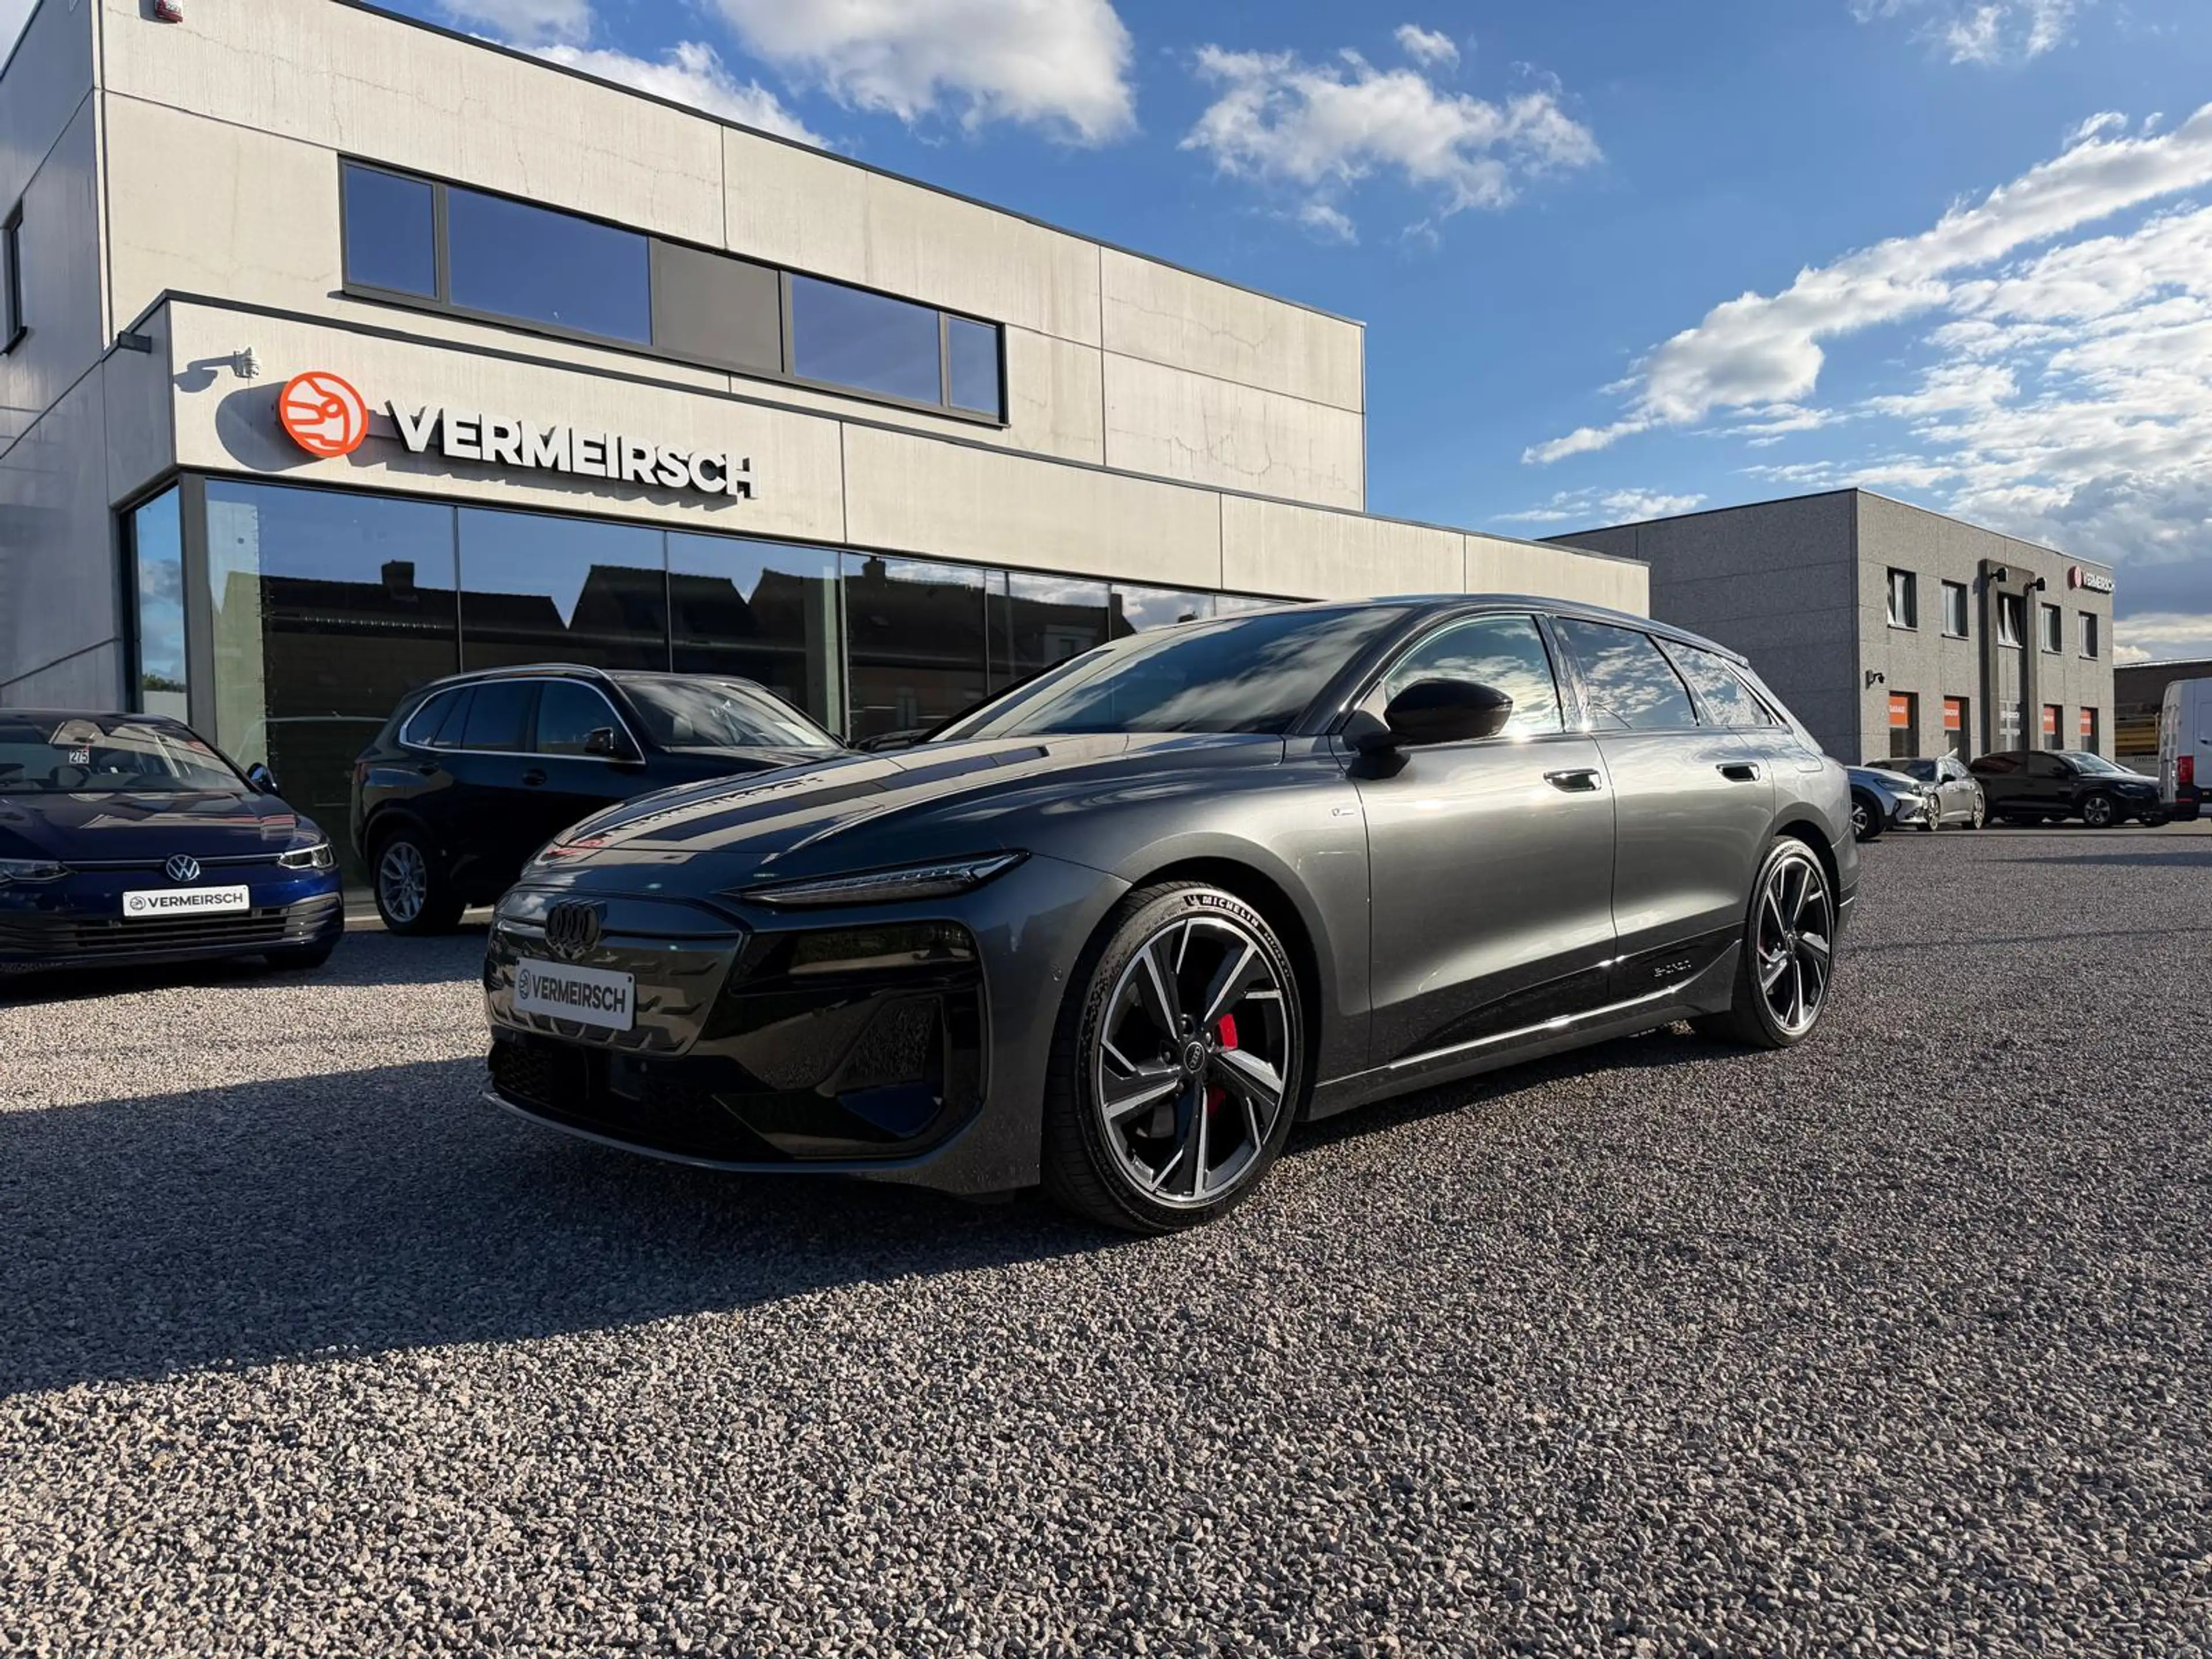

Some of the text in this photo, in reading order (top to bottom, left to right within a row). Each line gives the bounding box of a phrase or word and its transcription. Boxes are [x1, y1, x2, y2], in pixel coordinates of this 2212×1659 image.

[385, 400, 760, 499] VERMEIRSCH
[147, 892, 243, 908] VERMEIRSCH
[1202, 895, 1259, 927] MICHELIN
[532, 974, 626, 1013] VERMEIRSCH
